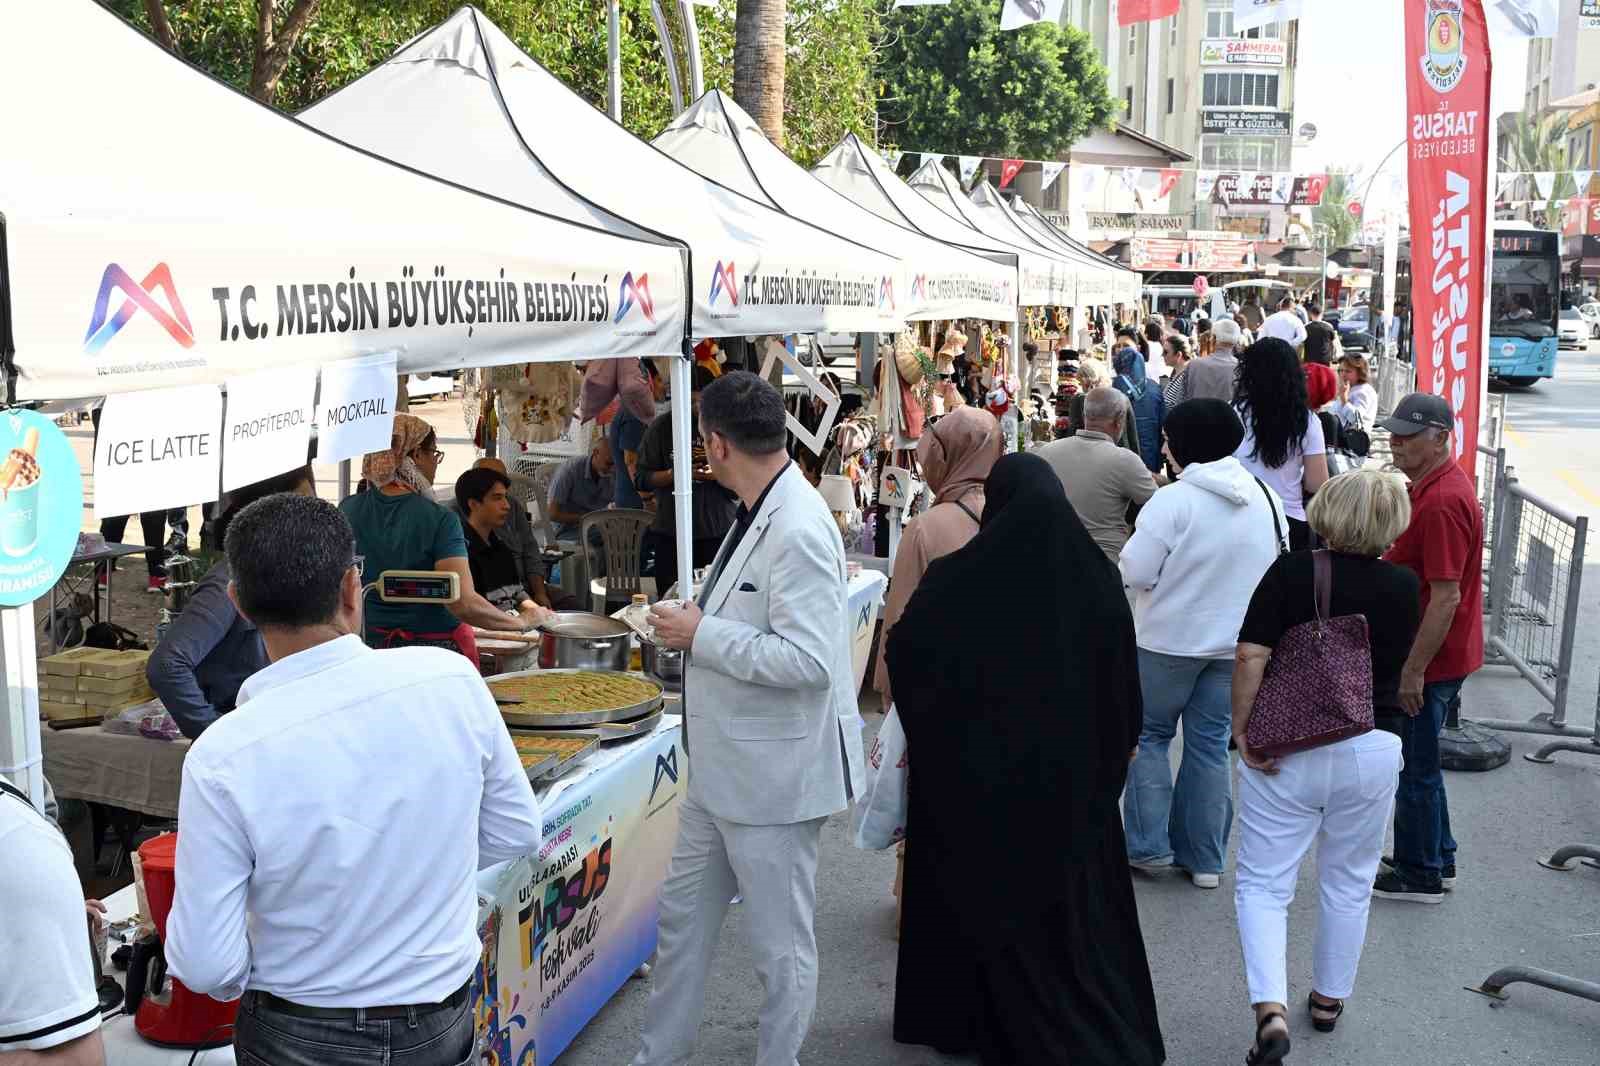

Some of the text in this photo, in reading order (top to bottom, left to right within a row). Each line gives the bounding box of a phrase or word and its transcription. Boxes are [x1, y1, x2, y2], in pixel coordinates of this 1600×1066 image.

[1203, 119, 1237, 128] ESTETİK
[1245, 119, 1285, 129] GÜZELLİK
[1092, 215, 1137, 228] BOYAMA
[1140, 216, 1183, 228] SALONU
[212, 265, 609, 341] T.C. MERSİN BÜYÜKŞEHİR BELEDİYESİ
[743, 267, 877, 312] T.C. MERSİN BÜYÜKŞEHİR BELEDİYESİ
[232, 408, 306, 442] PROFİTEROL
[327, 398, 388, 427] MOCKTAIL
[106, 433, 210, 466] ICE LATTE
